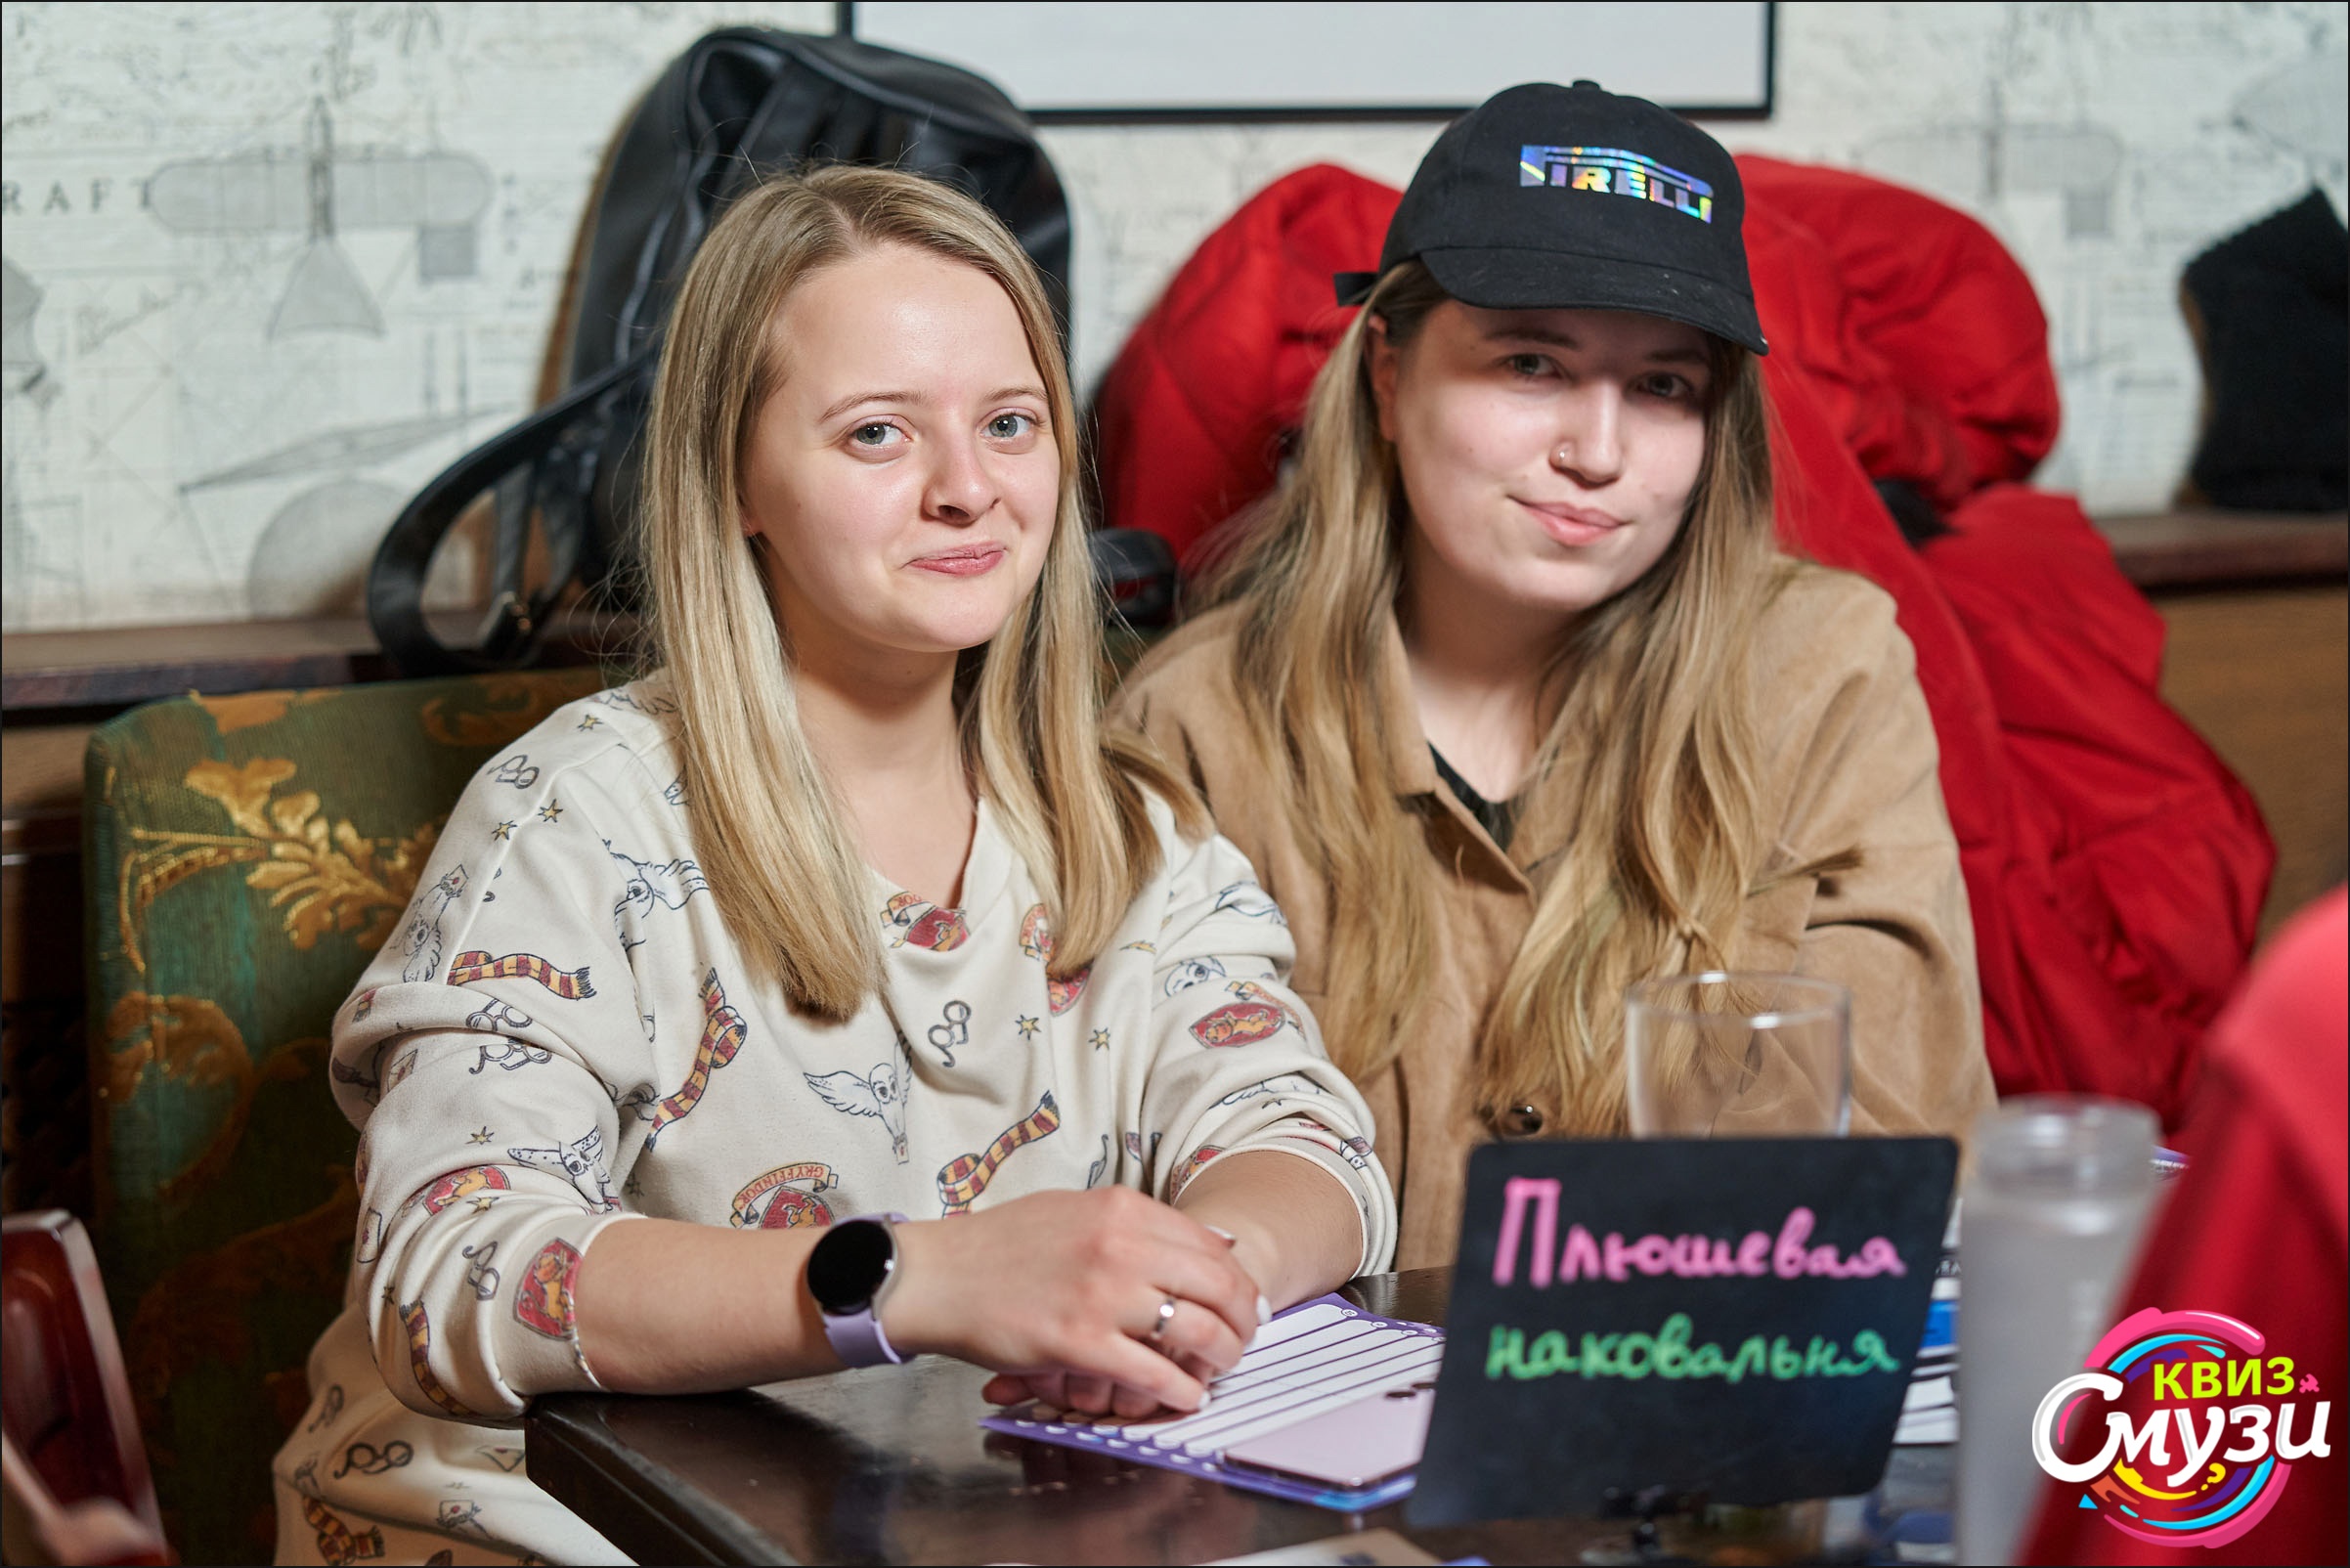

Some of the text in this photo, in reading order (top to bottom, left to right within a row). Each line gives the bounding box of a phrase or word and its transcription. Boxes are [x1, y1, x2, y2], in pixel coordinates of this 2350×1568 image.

[1520, 145, 1714, 224] PIRELLI
[1492, 1176, 1908, 1288] Плюшевая
[1486, 1313, 1901, 1384] наковальня
